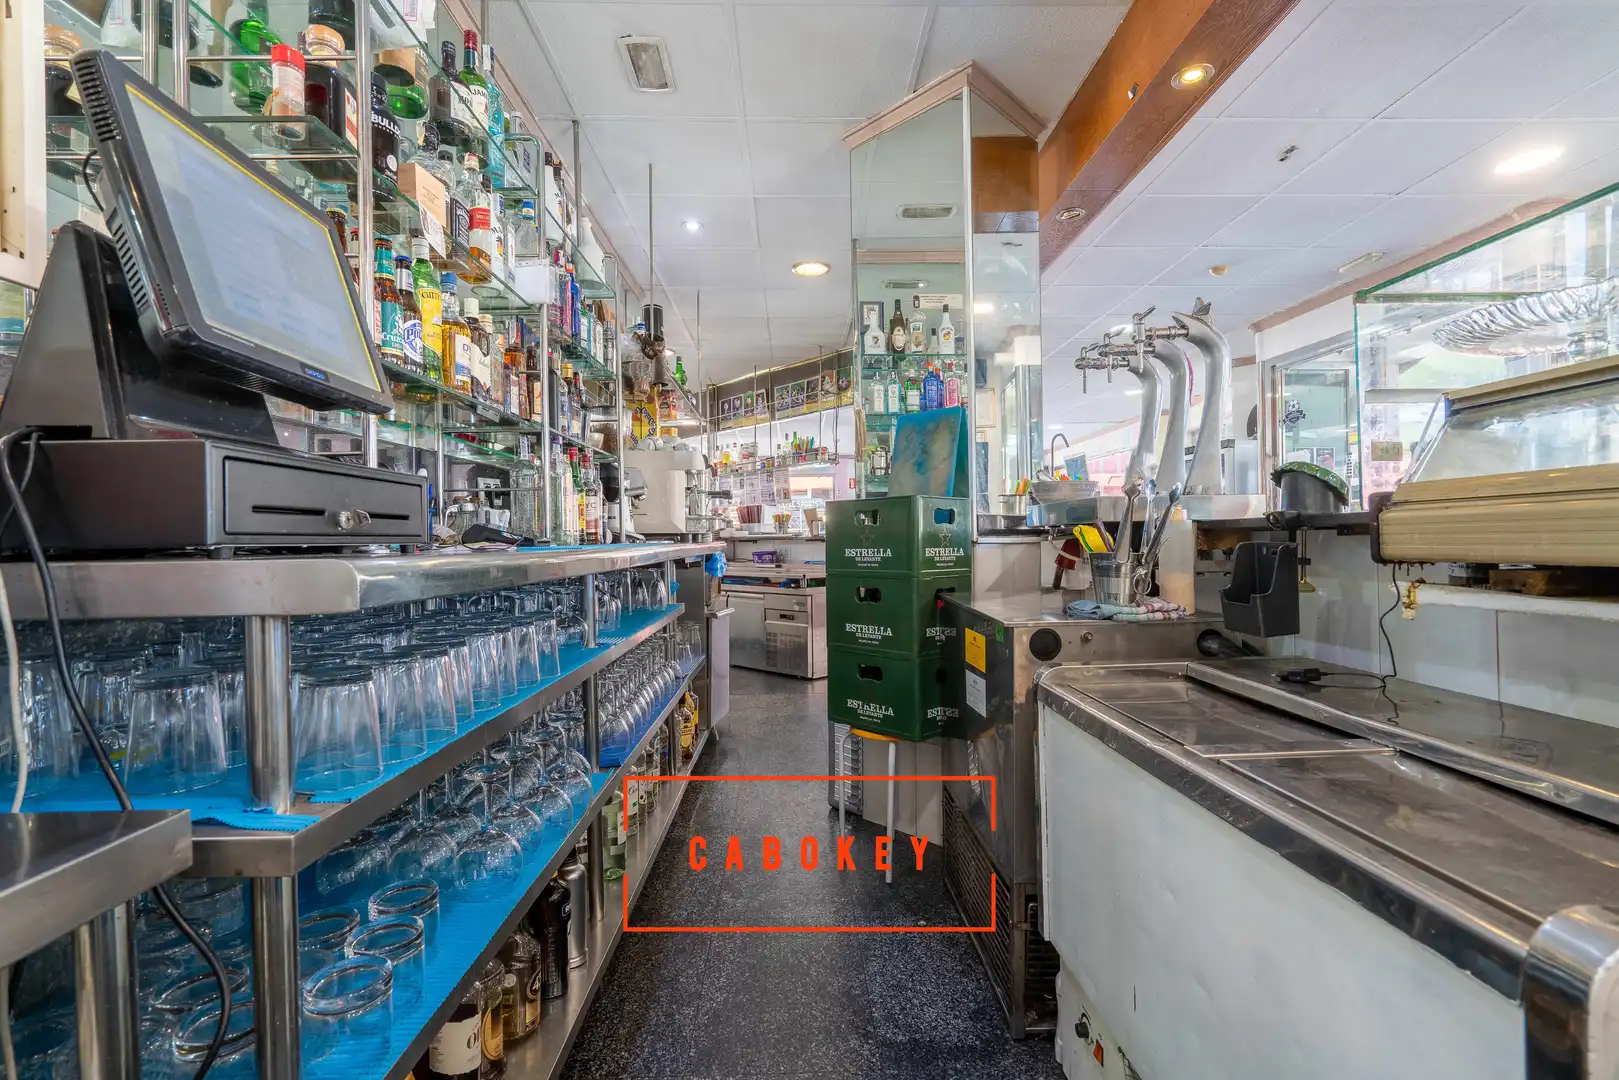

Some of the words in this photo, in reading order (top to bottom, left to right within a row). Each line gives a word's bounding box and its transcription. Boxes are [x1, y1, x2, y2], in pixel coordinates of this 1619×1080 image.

[844, 548, 892, 557] ESTRELLA
[925, 547, 964, 556] ESTRELLA
[845, 623, 893, 636] ESTRELLA
[847, 698, 894, 716] ESTRELLA
